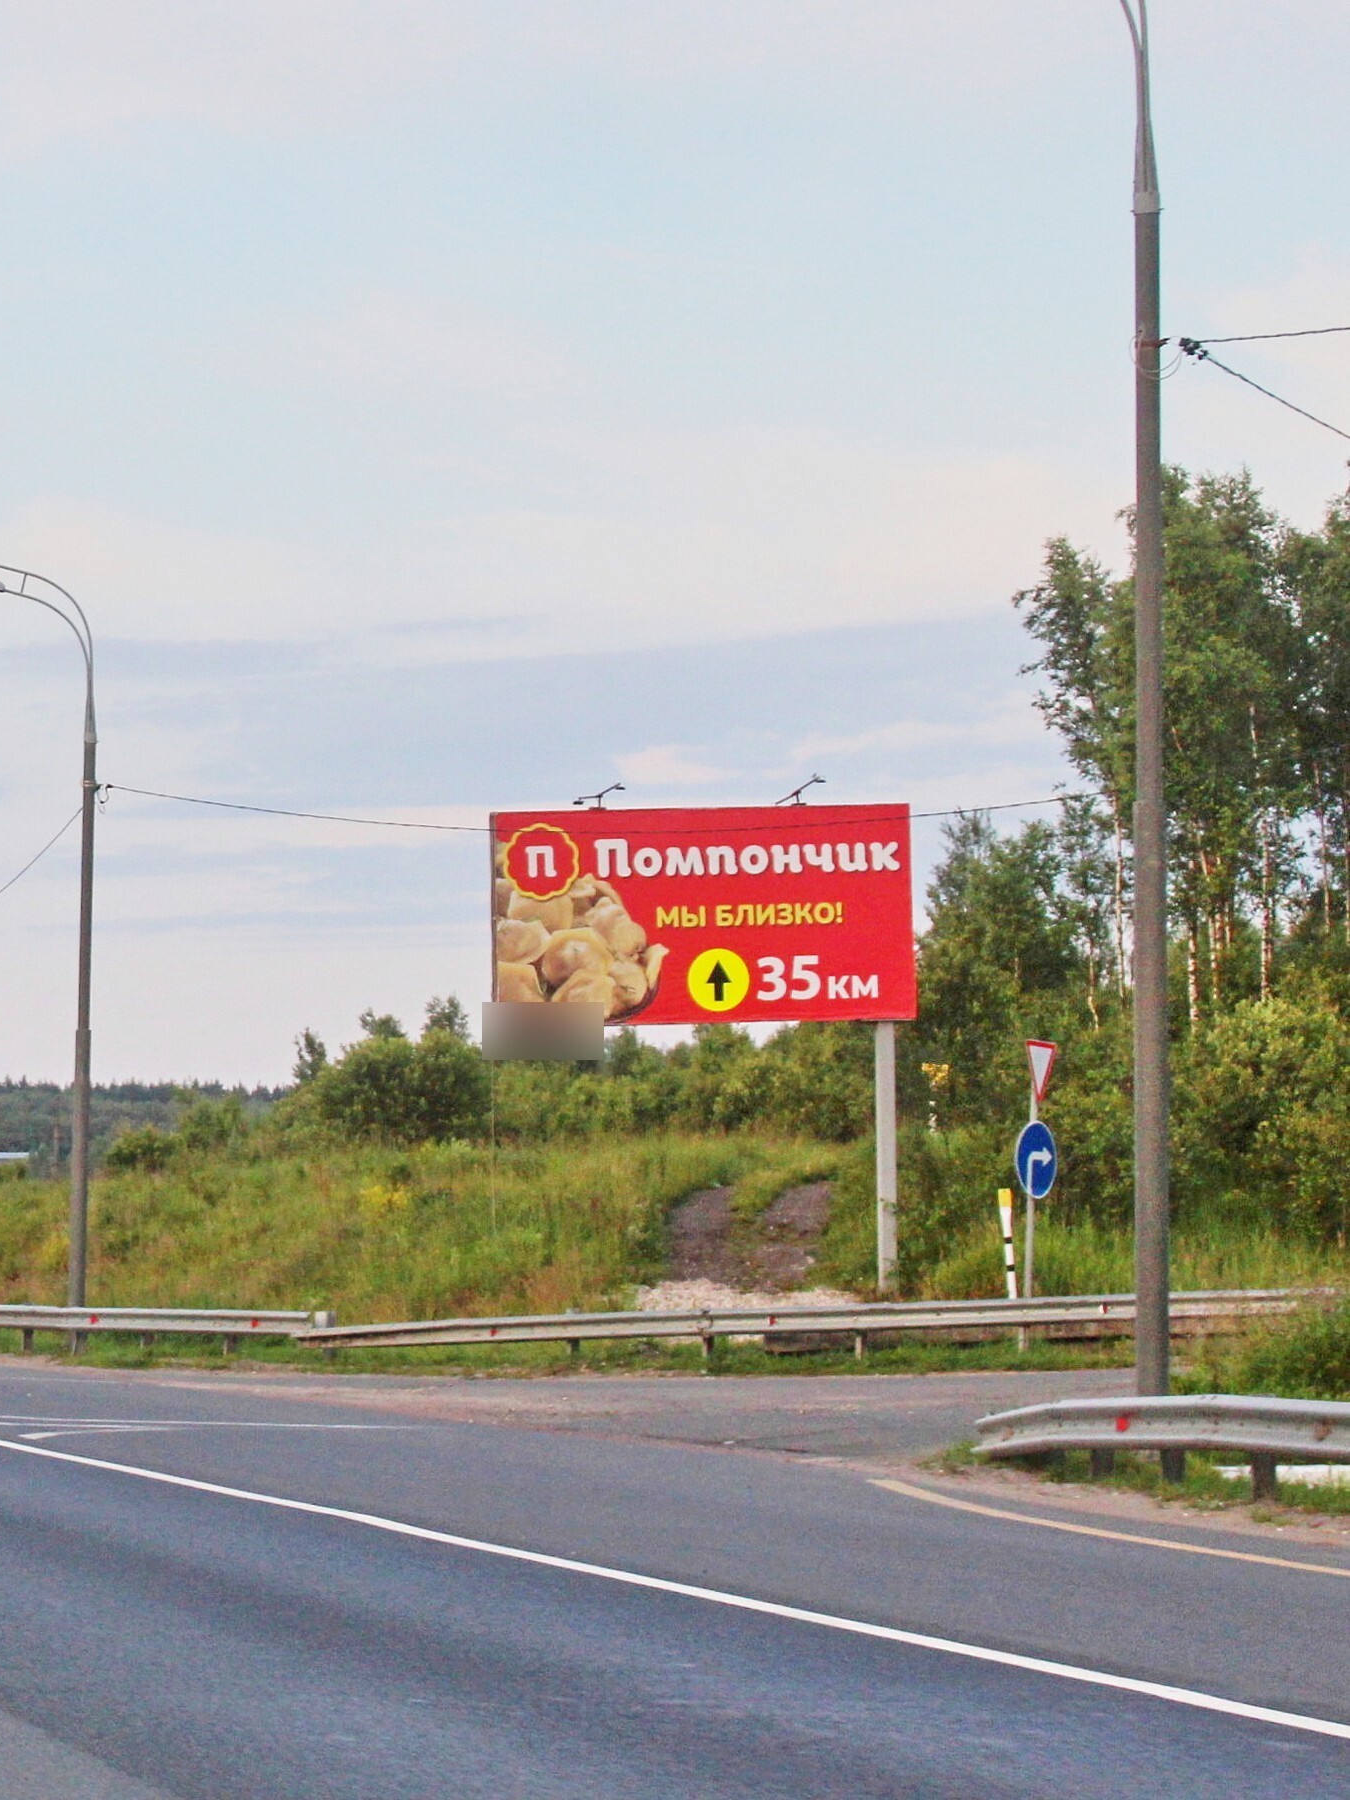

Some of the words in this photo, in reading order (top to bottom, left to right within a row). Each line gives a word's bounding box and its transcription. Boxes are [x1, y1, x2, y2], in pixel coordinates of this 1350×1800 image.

[593, 838, 900, 878] Помпончик
[656, 905, 706, 928] МЫ
[716, 902, 844, 927] БЛИЗКО!
[756, 955, 821, 1001] 35
